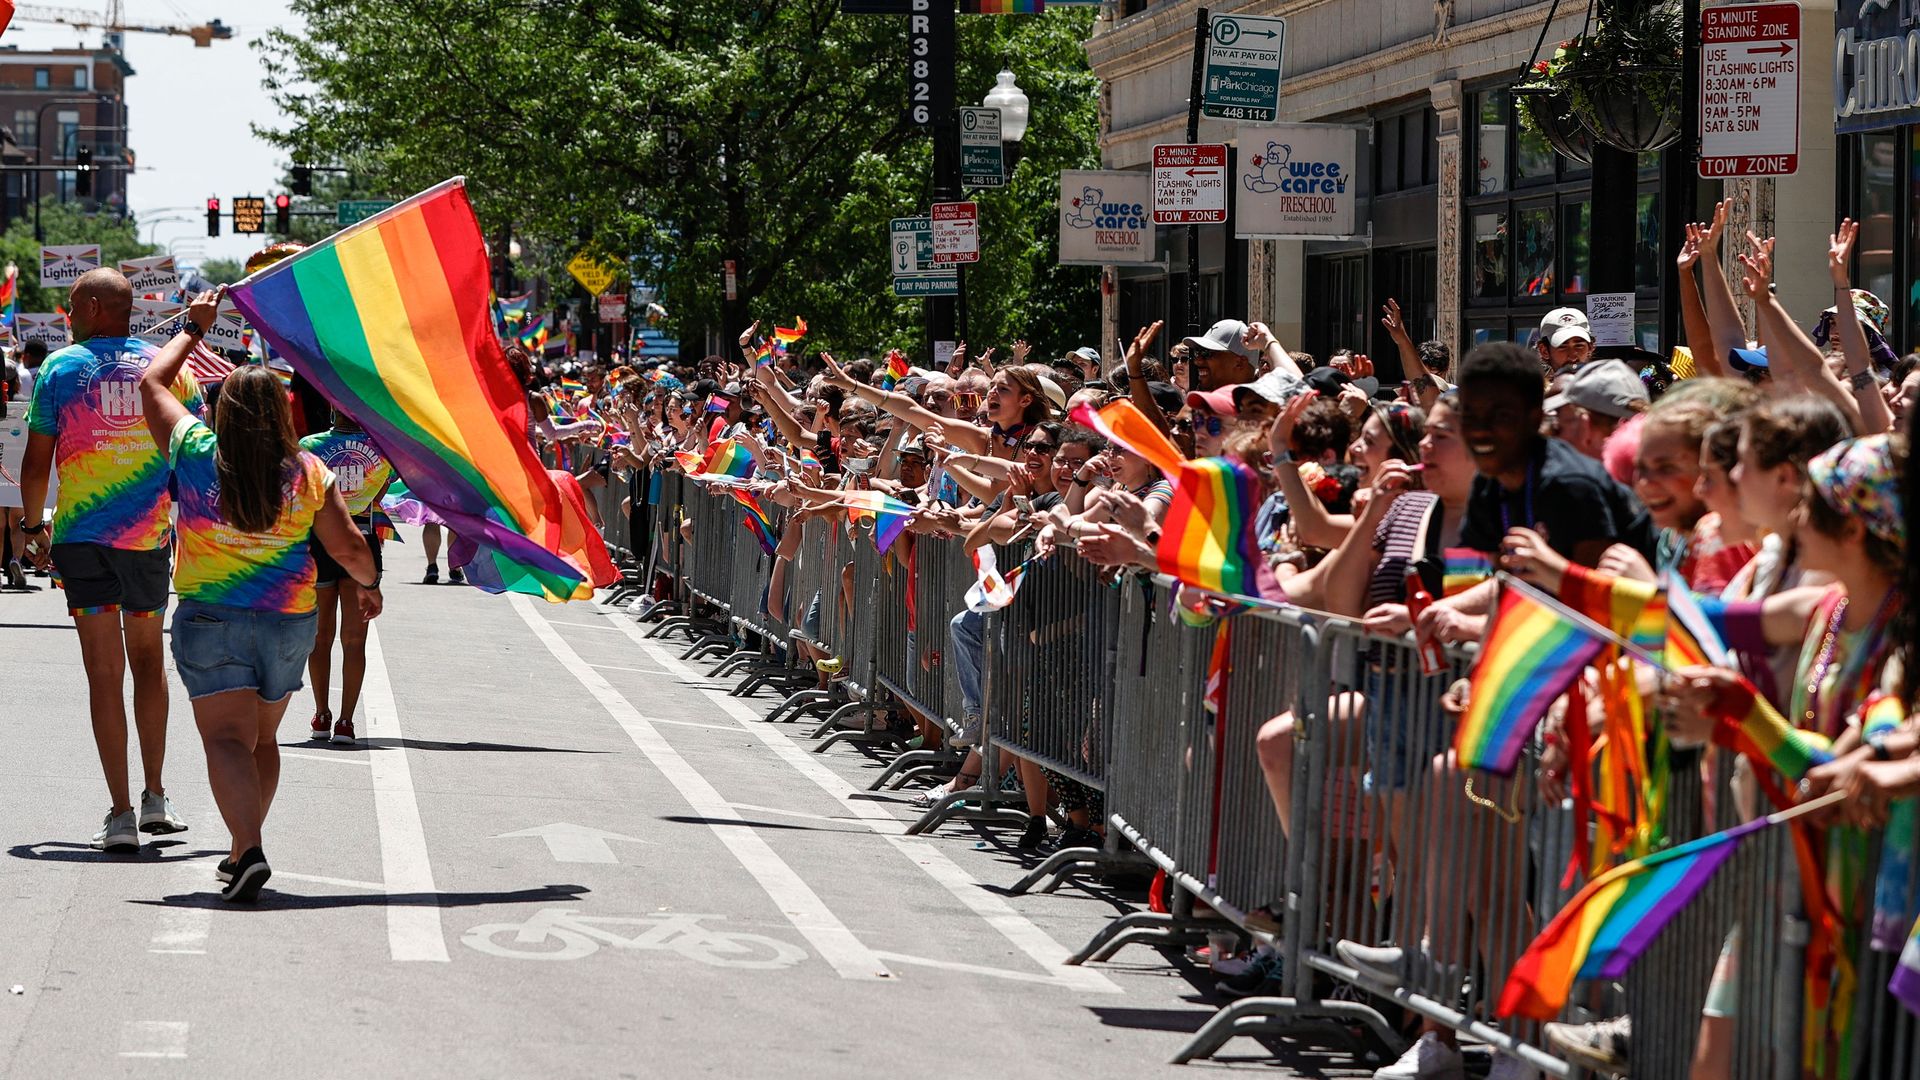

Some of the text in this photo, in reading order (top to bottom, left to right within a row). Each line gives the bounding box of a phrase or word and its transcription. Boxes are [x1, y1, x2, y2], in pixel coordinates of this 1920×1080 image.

[1707, 11, 1758, 24] 15 MINUTE
[1707, 24, 1789, 39] STANDING ZONE
[1241, 52, 1257, 60] PAY
[1259, 53, 1277, 61] BOX
[1707, 50, 1727, 61] USE
[1706, 61, 1794, 76] FLASHING LIGHTS
[1705, 93, 1727, 105] MON
[1735, 92, 1752, 103] FRI
[1223, 107, 1244, 118] 448
[1247, 109, 1268, 120] 114
[1705, 120, 1759, 132] SAT & SUN
[1158, 148, 1198, 156] 15 MINUTE
[1158, 156, 1218, 165] STANDING ZONE
[1705, 157, 1788, 174] TOW ZONE
[1158, 171, 1172, 179] USE
[1290, 162, 1340, 177] wee
[1281, 178, 1335, 194] care
[1102, 203, 1143, 216] wee
[1280, 196, 1336, 214] PRESCHOOL
[1095, 216, 1138, 230] care
[1158, 211, 1220, 222] TOW ZONE
[896, 222, 912, 231] PAY
[914, 221, 926, 230] TO
[1095, 231, 1140, 245] PRESCHOOL
[130, 275, 176, 290] ightfoot
[896, 282, 900, 290] 7
[915, 282, 930, 290] PAID
[932, 281, 958, 290] PARKING
[321, 447, 336, 460] ELS
